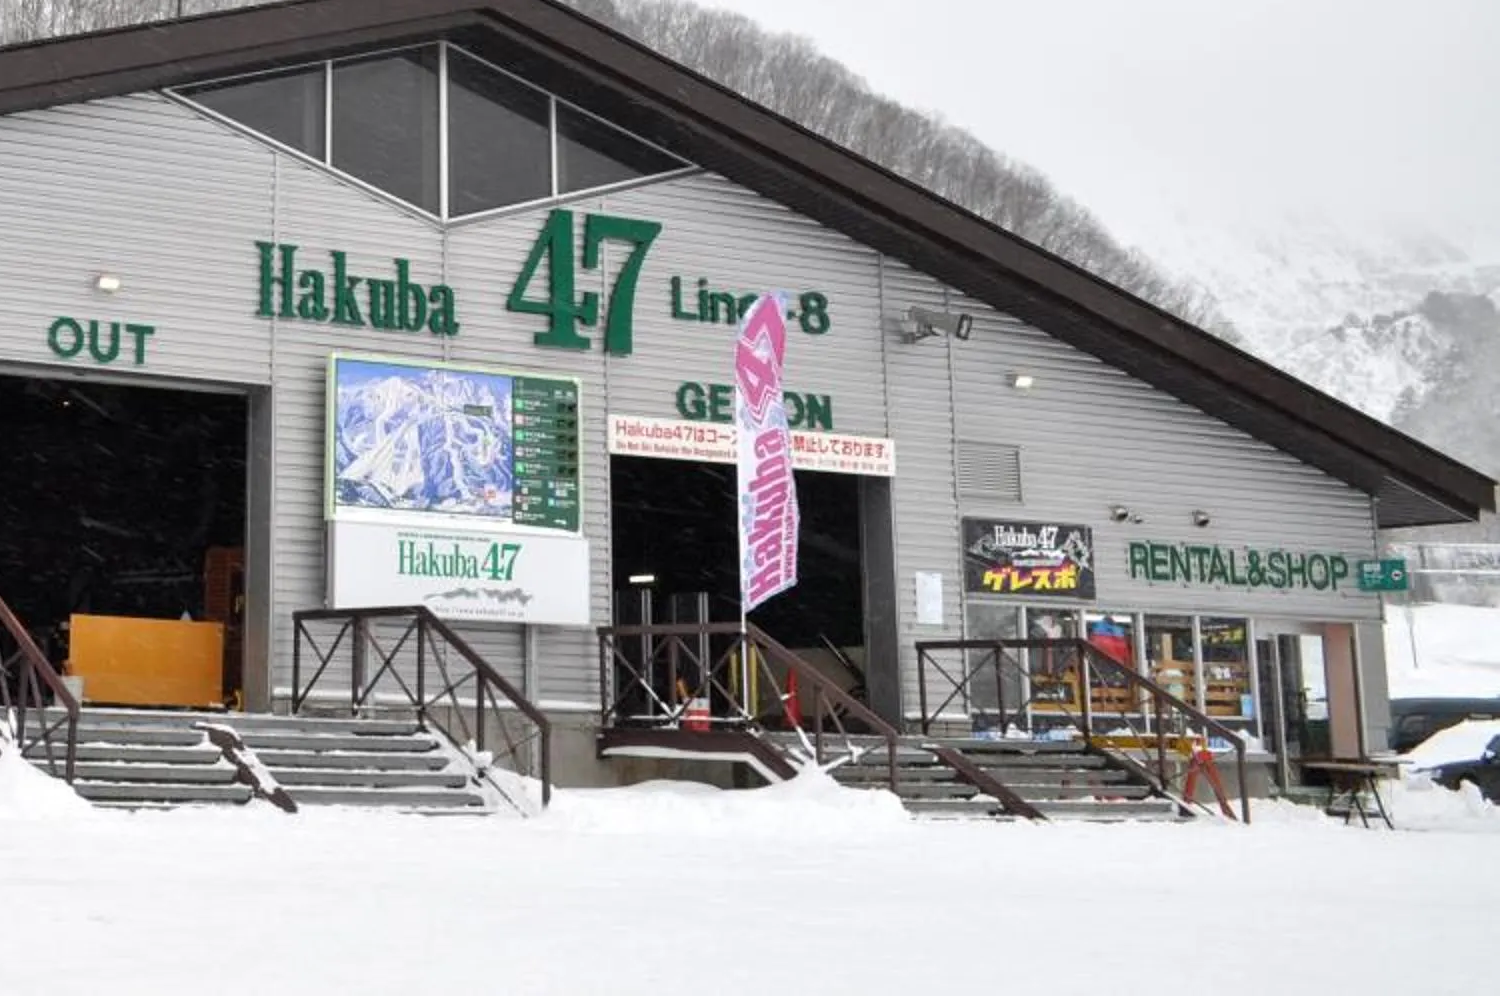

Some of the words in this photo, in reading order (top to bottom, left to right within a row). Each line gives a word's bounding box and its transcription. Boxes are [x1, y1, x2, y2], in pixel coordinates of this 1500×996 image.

[255, 241, 460, 336] Hakuba
[506, 208, 662, 356] 47
[47, 317, 155, 365] OUT
[676, 381, 833, 429] GEON
[748, 427, 788, 601] Hakuba
[1038, 526, 1059, 549] 47
[397, 539, 479, 579] Hakuba
[481, 541, 522, 581] 47
[1130, 541, 1349, 592] RENTAL&SHOP
